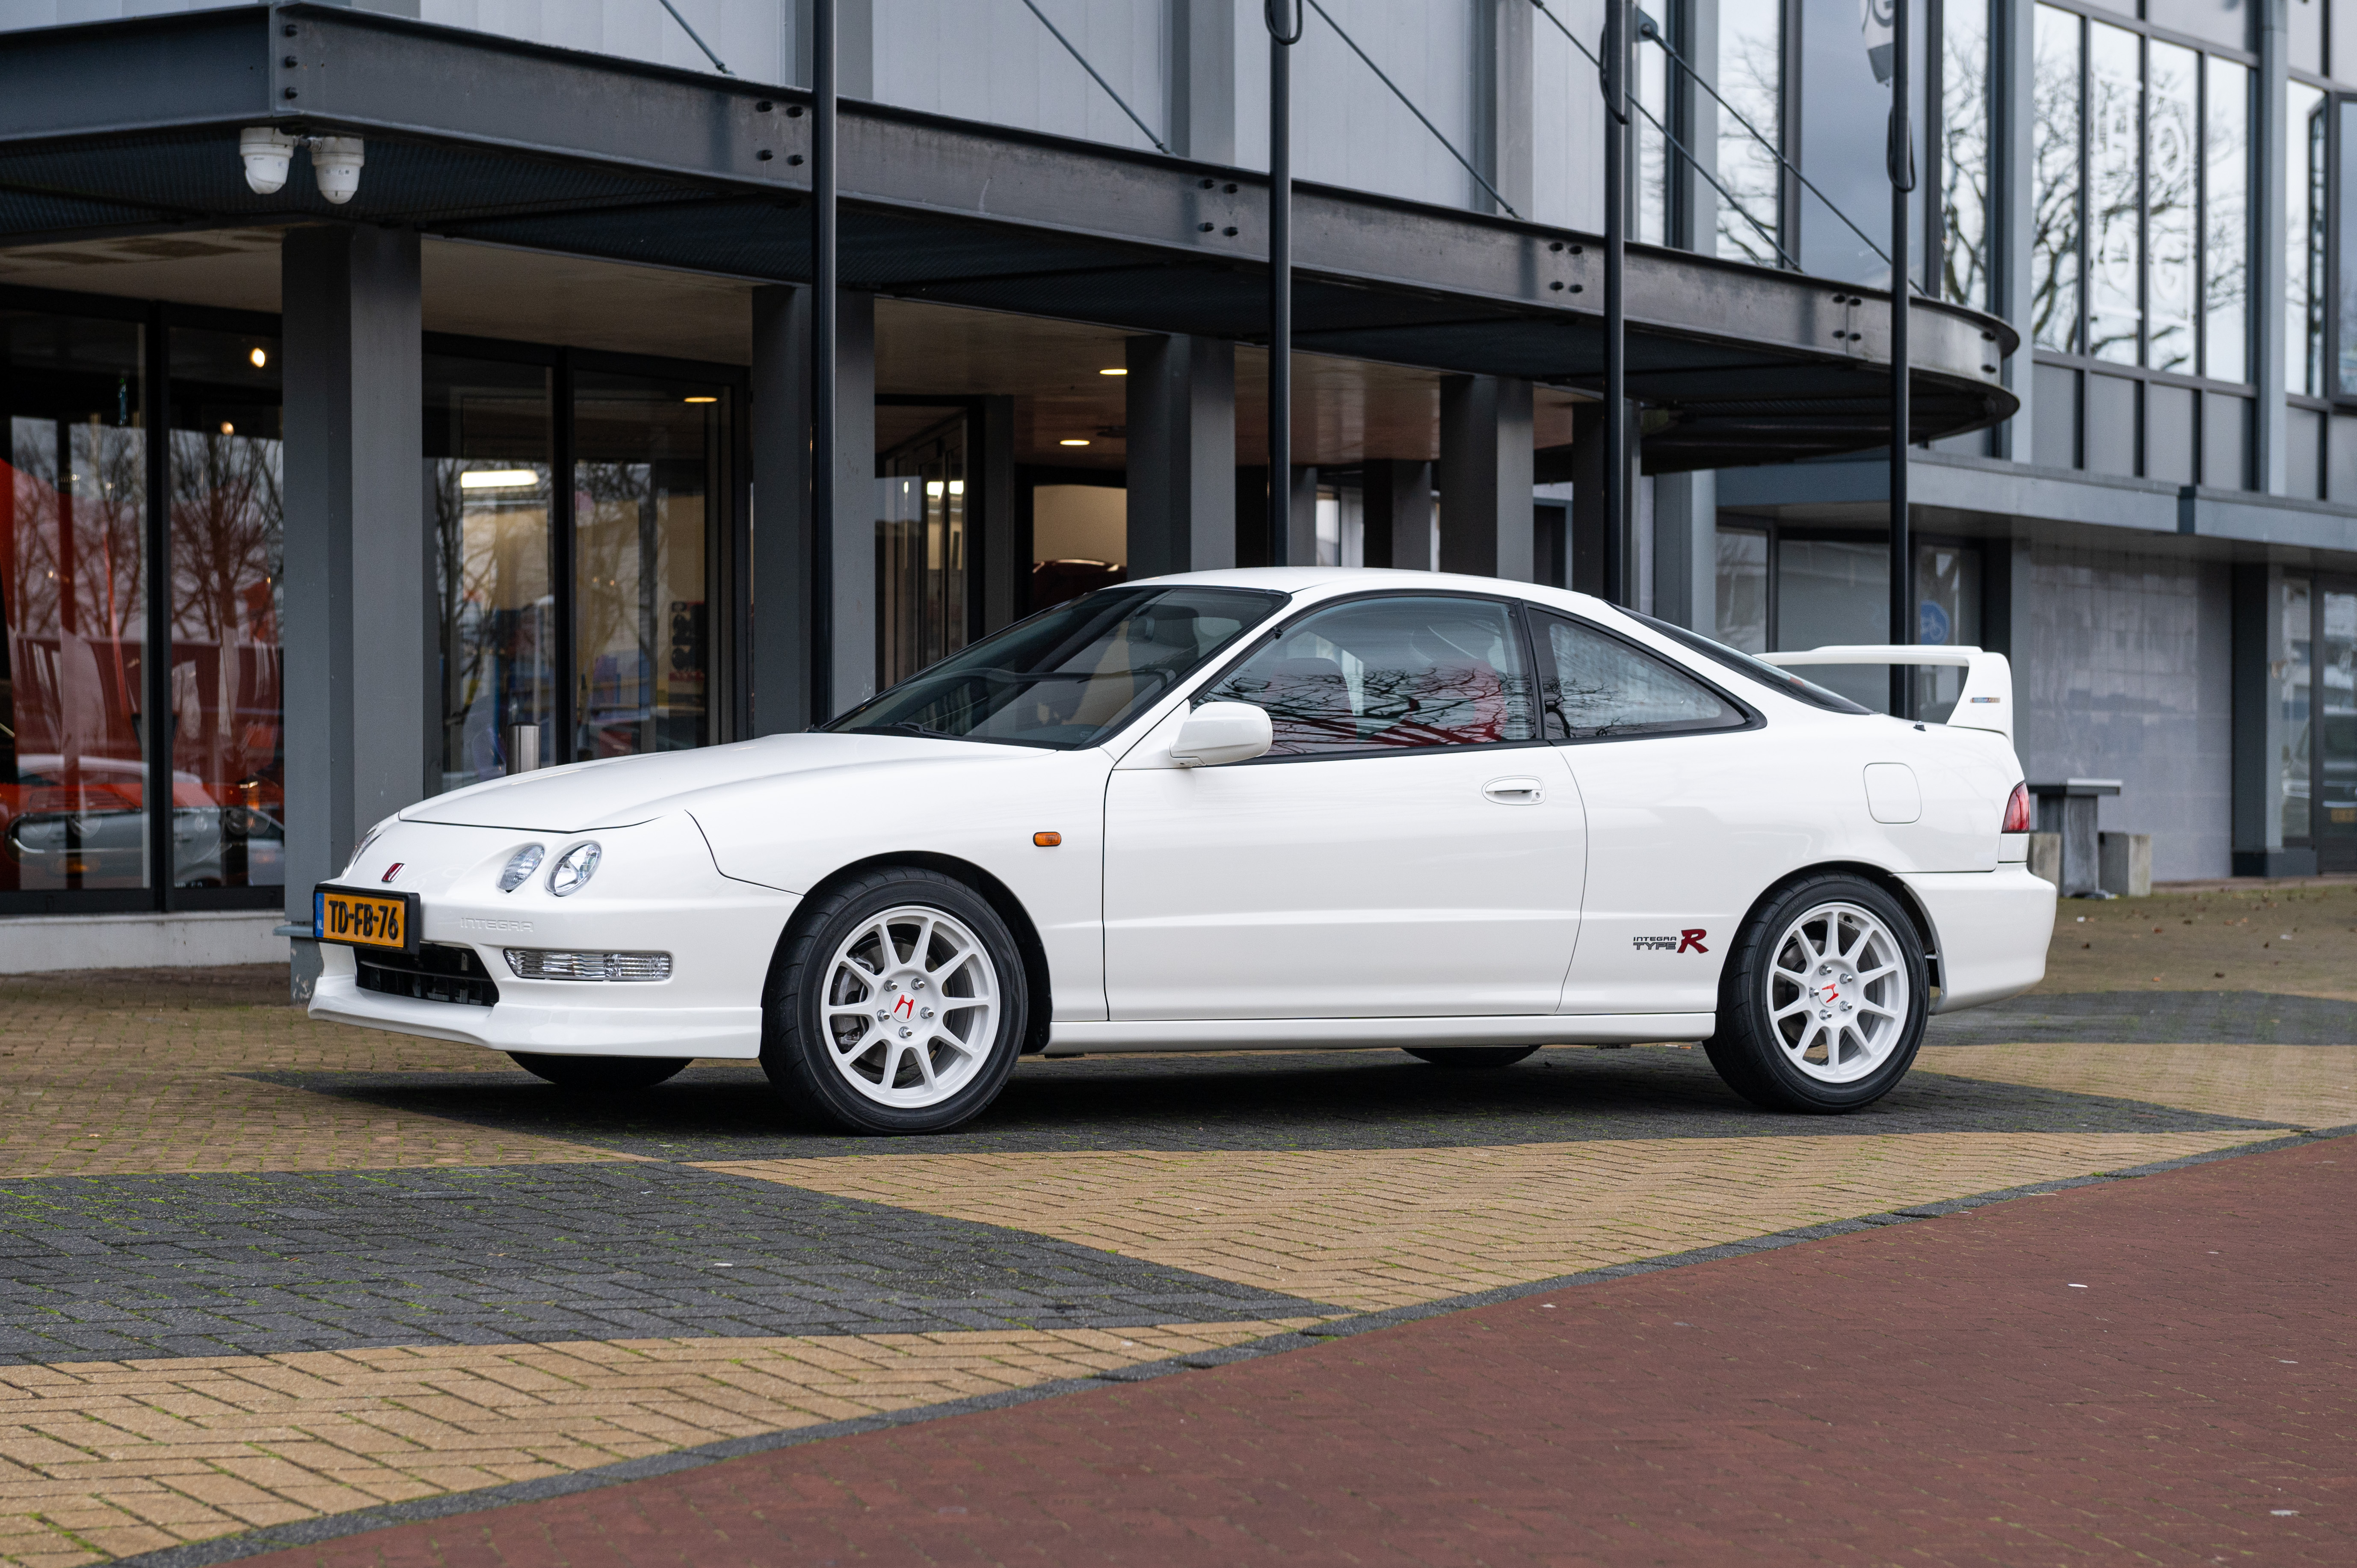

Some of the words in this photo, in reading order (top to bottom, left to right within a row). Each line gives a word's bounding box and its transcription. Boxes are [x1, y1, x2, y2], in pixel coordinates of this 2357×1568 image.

[317, 920, 323, 930] NL
[329, 900, 399, 940] TD-FB-76
[460, 917, 534, 932] INTEGRA
[1633, 942, 1676, 950] TYPE
[1677, 929, 1709, 954] R
